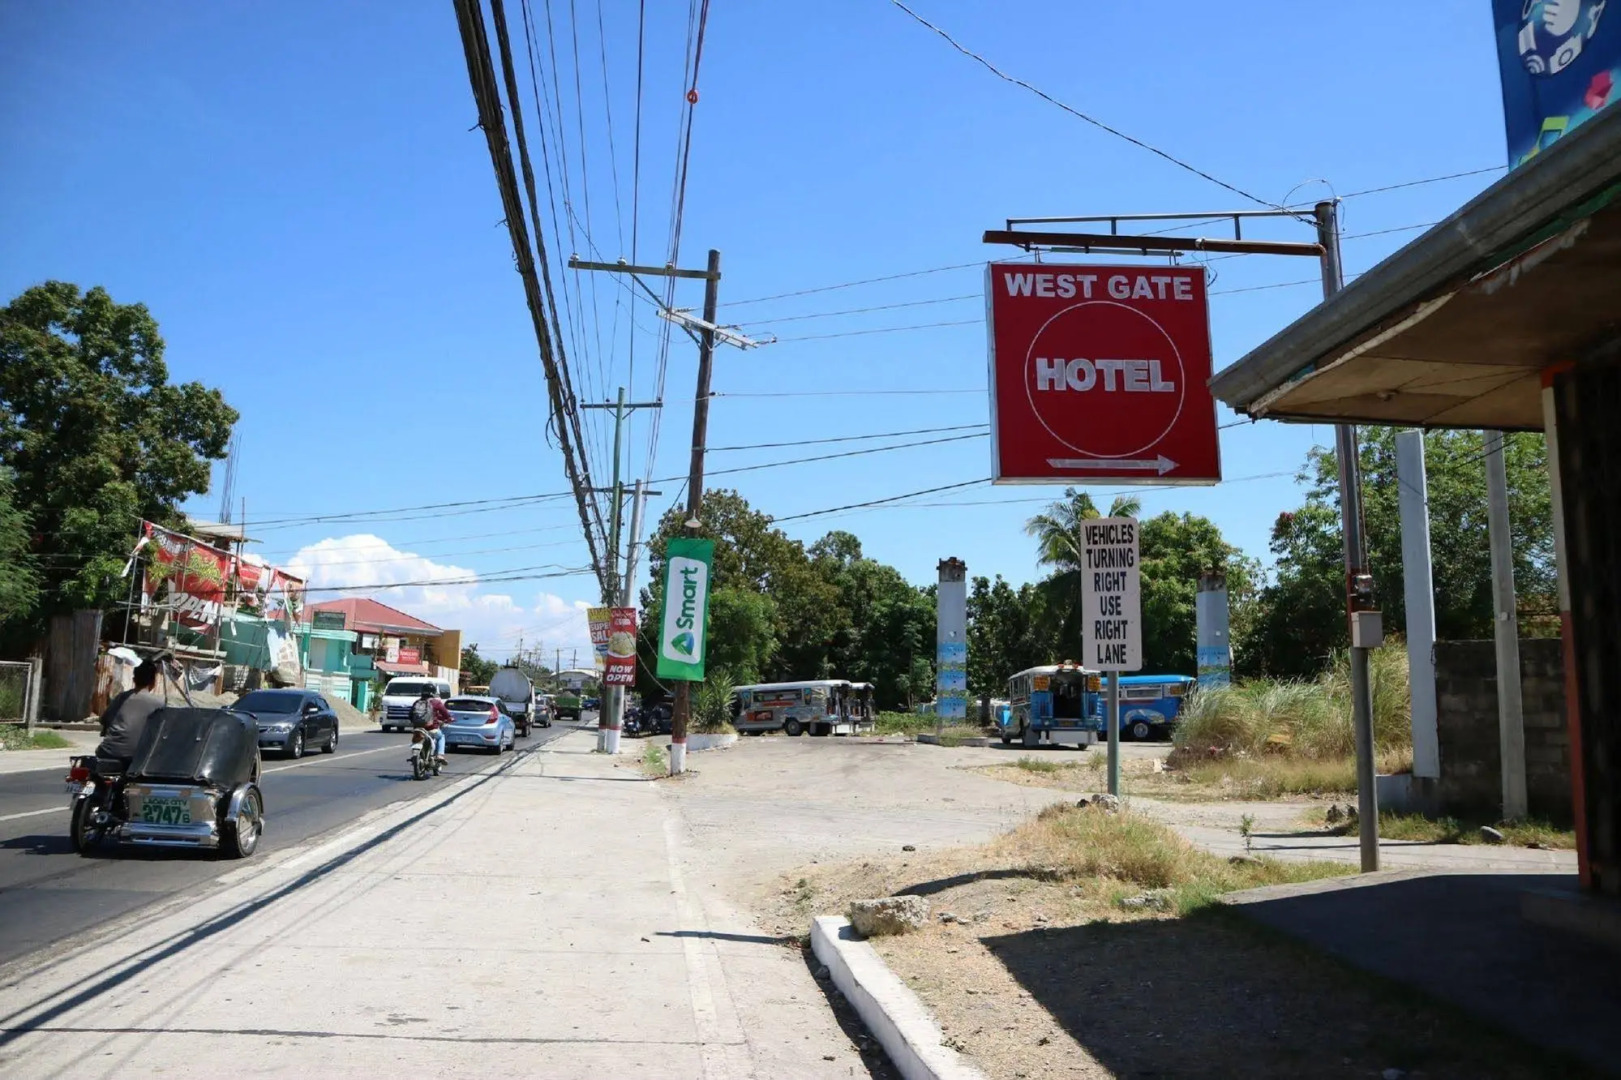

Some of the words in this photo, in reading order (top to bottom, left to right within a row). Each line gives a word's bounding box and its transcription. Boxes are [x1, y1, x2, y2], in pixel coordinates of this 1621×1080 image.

[1004, 273, 1097, 298] WEST
[1108, 275, 1193, 300] GATE
[1035, 358, 1175, 392] HOTEL
[1085, 524, 1134, 545] VEHICLES
[1086, 547, 1134, 569] TURNING
[1094, 571, 1127, 592] RIGHT
[676, 566, 698, 630] Smart
[1100, 596, 1121, 616] USE
[590, 622, 609, 631] SUPE
[591, 631, 609, 642] SAL
[1095, 620, 1128, 640] RIGHT
[1097, 644, 1127, 664] LANE
[606, 674, 633, 682] OPEN
[609, 665, 633, 673] NOW
[142, 804, 181, 824] 2747
